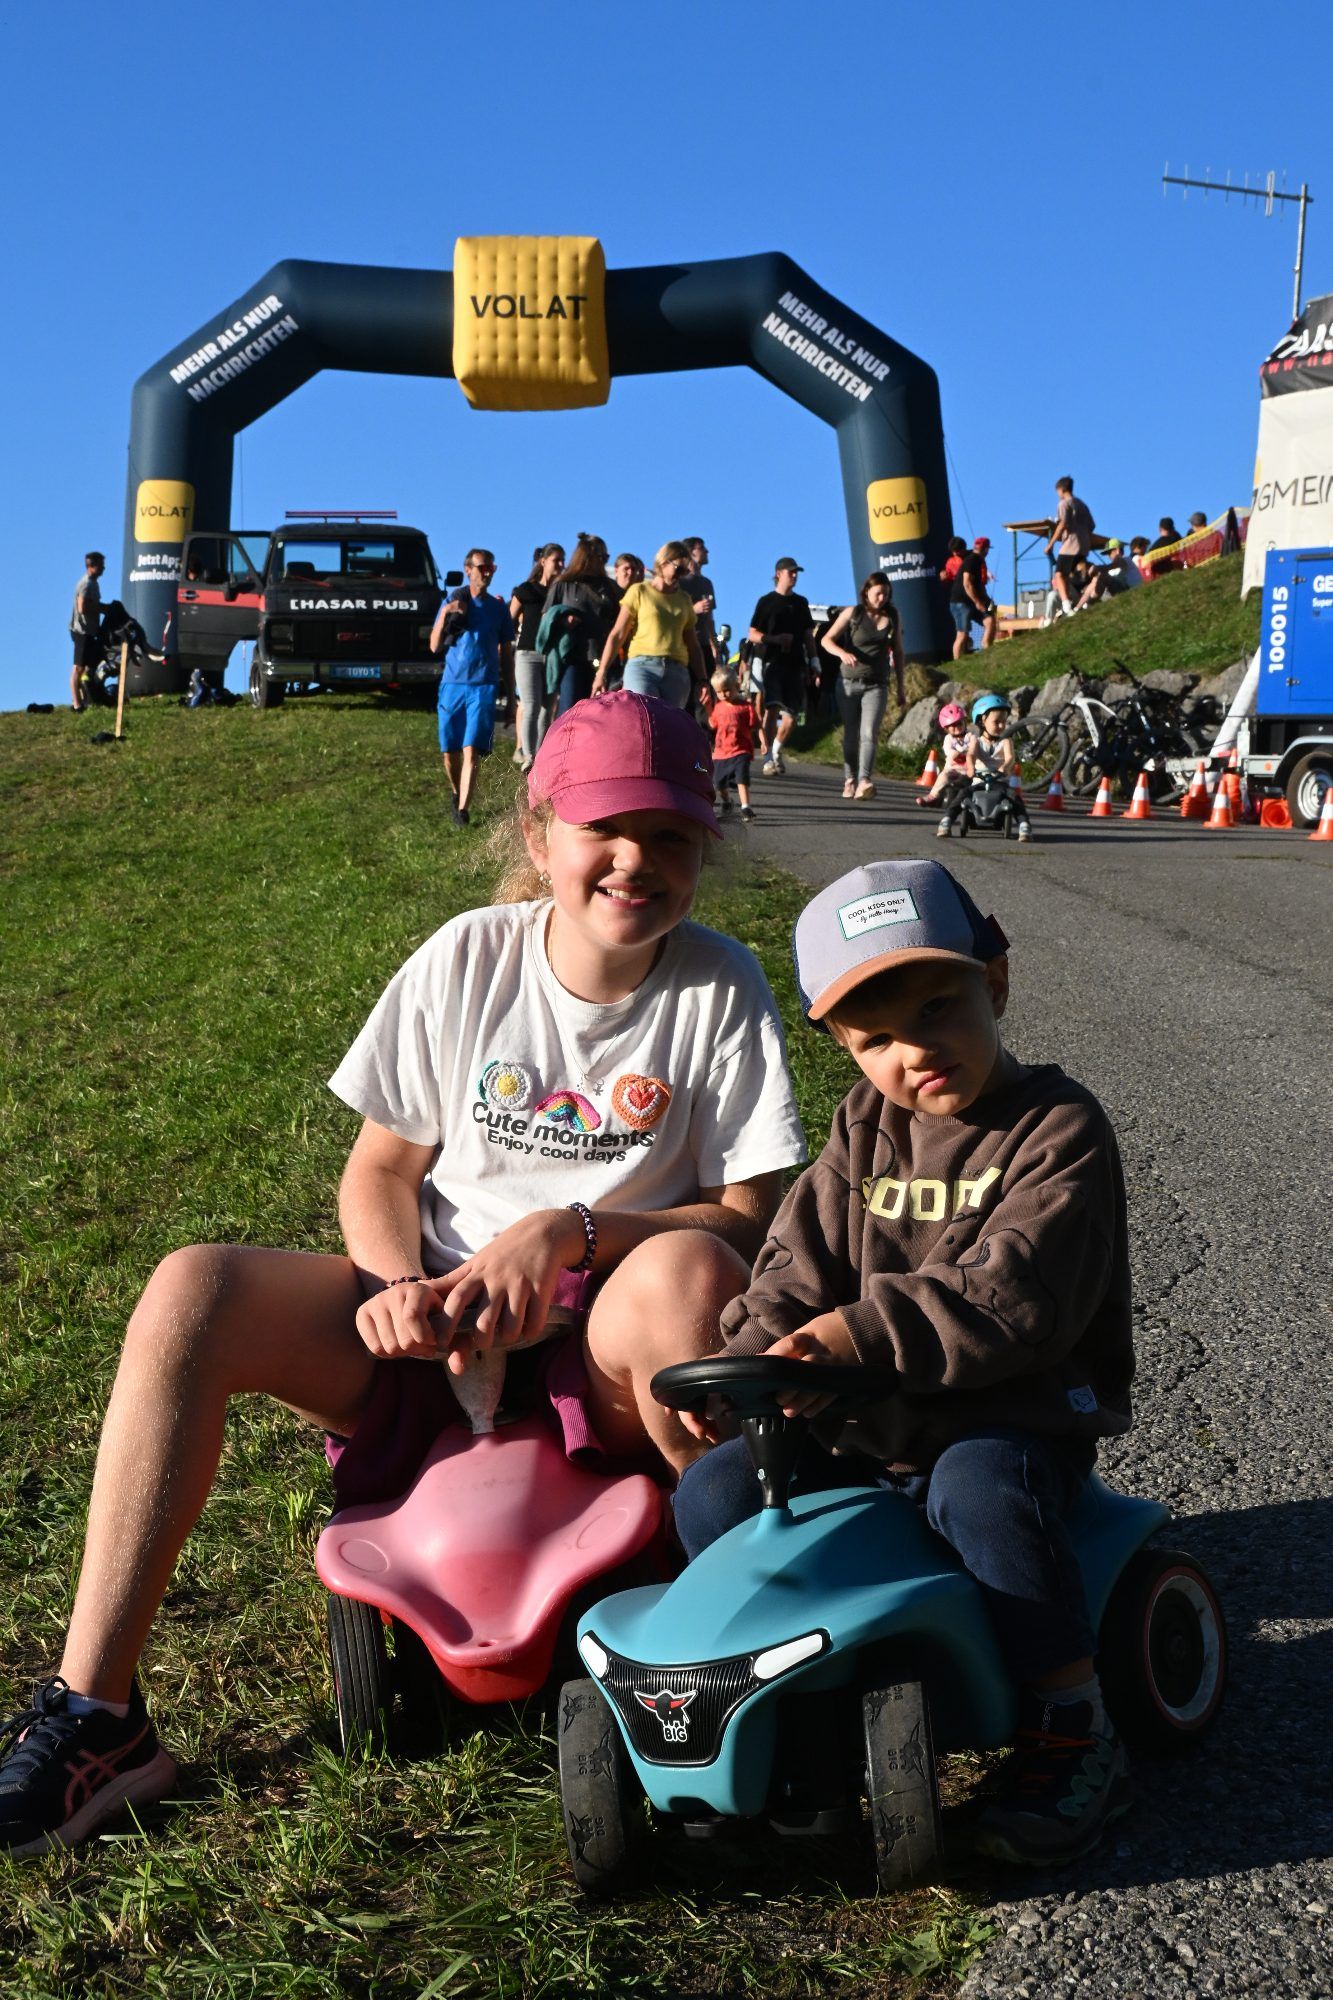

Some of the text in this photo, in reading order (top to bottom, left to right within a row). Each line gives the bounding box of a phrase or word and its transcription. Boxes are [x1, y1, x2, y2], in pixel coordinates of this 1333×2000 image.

[469, 294, 588, 320] VOL.AT
[169, 295, 283, 385] MEHR ALS NUR
[778, 290, 891, 381] MEHR ALS NUR
[187, 314, 300, 402] NACHRICHTEN
[762, 311, 874, 402] NACHRICHTEN
[140, 505, 190, 518] VOL.AT
[873, 502, 923, 518] VOL.AT
[137, 554, 161, 568] Jetzt
[879, 552, 925, 570] Jetzt App
[1268, 586, 1289, 674] 100015
[847, 898, 906, 920] COOL KIDS ONLY
[472, 1101, 655, 1148] Cute moments
[487, 1129, 627, 1165] Enjoy cool days
[662, 1726, 688, 1742] BIG
